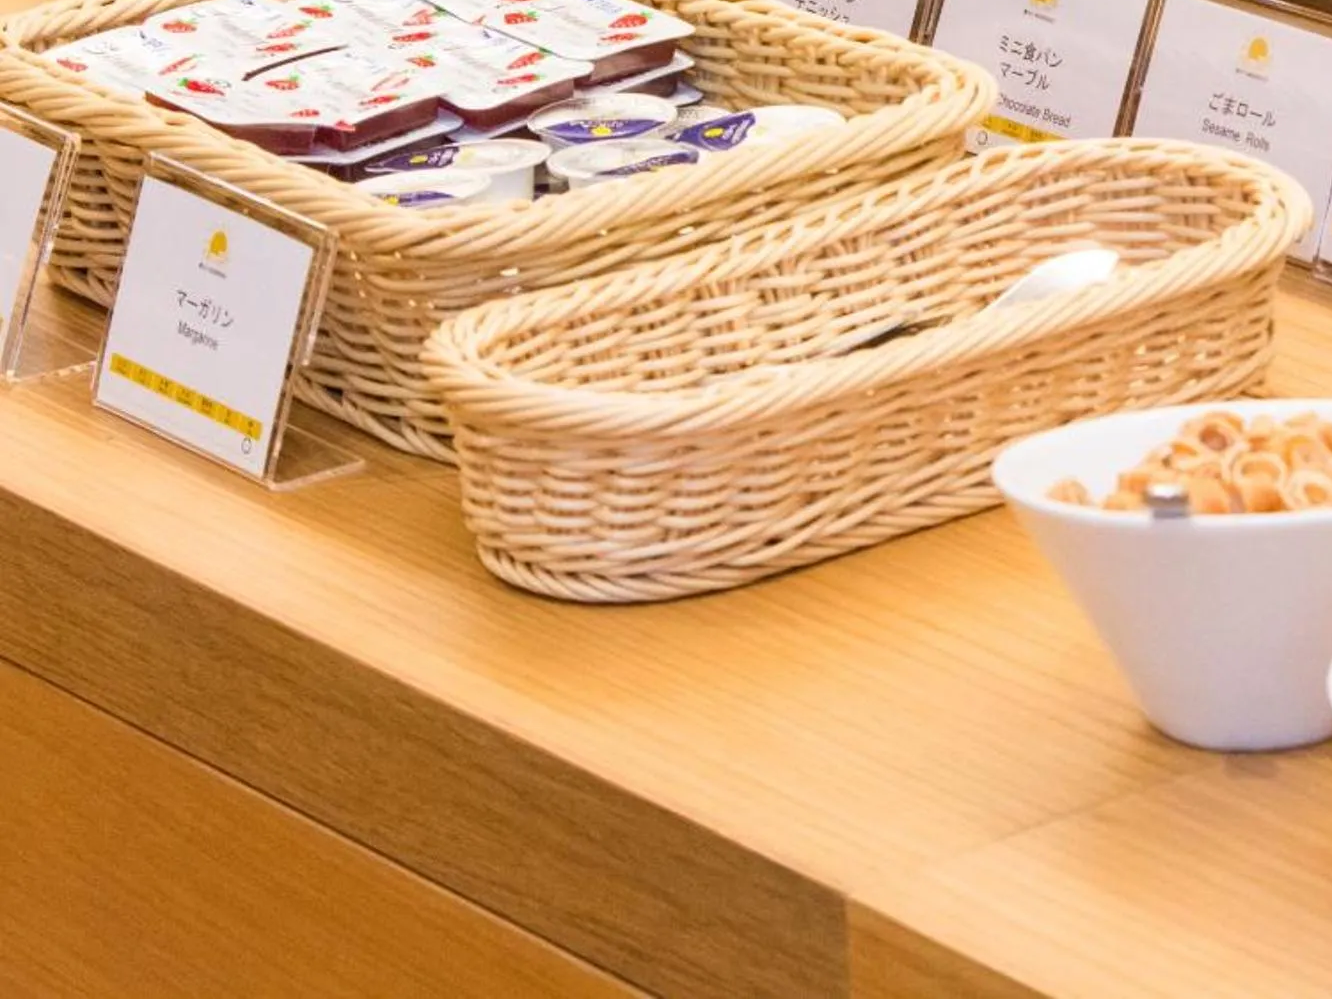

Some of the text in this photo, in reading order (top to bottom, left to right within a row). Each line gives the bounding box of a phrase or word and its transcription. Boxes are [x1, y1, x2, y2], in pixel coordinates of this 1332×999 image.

[999, 35, 1063, 68] ミニ食パン
[1000, 62, 1051, 90] マーブル
[1042, 108, 1071, 129] Bread
[1208, 92, 1277, 127] ごまロール
[1202, 117, 1241, 142] Sesame
[176, 289, 234, 328] マーガリン
[177, 320, 219, 351] Margarine
